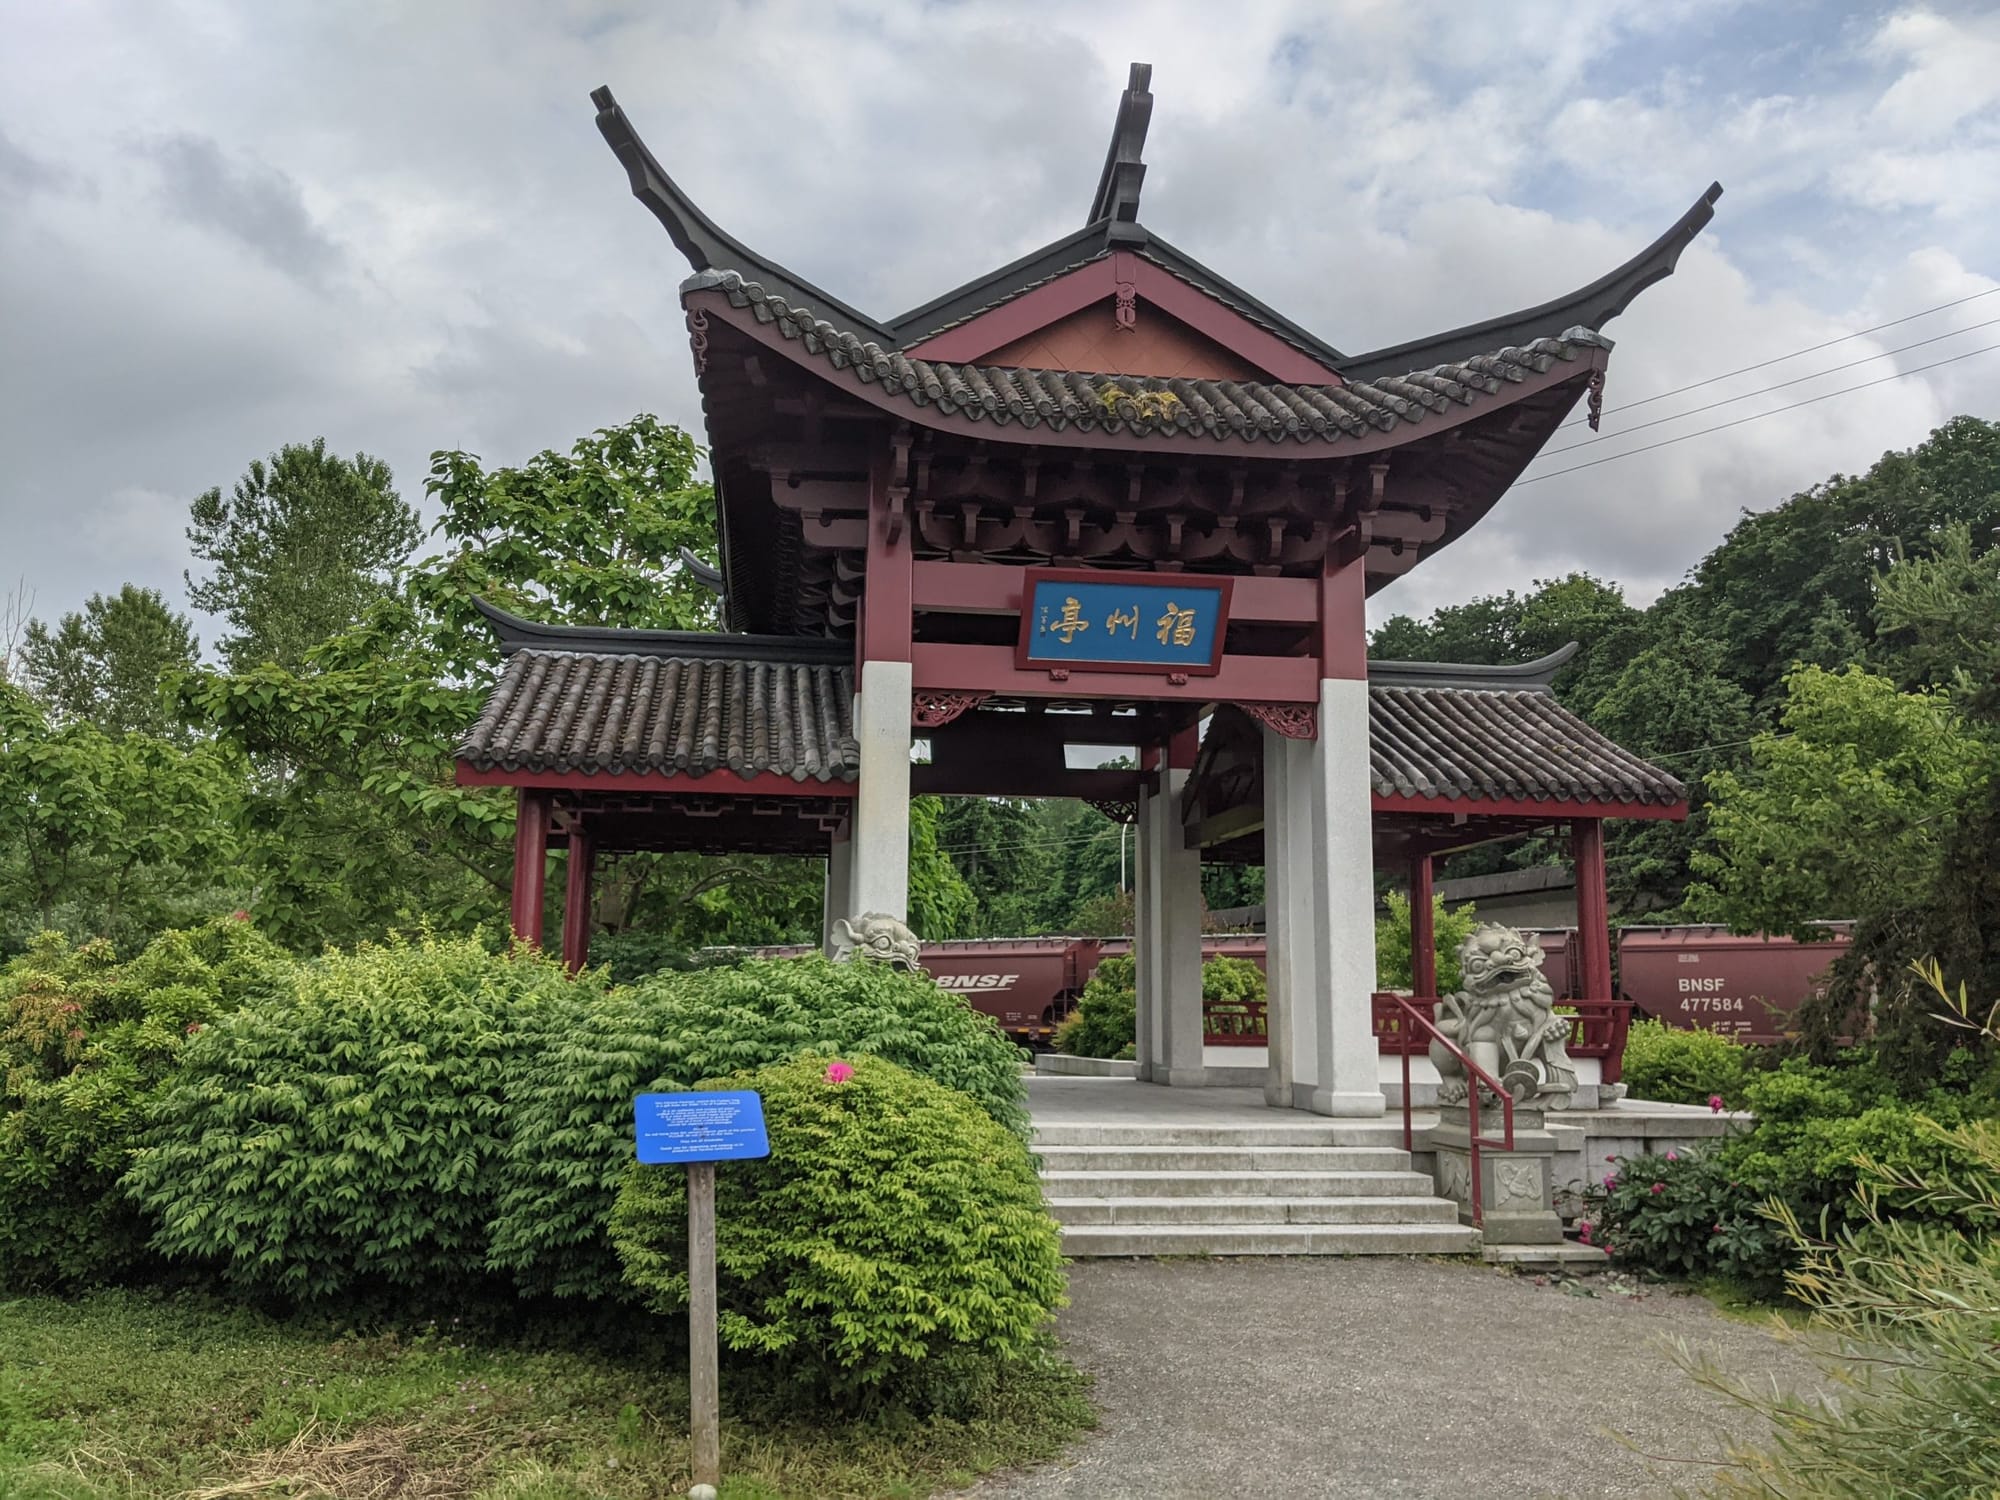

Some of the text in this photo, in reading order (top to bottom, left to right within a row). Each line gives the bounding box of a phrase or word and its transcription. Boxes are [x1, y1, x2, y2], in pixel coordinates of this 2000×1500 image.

[935, 974, 1020, 988] BNSF
[1678, 978, 1725, 993] BNSF
[1680, 997, 1744, 1012] 477584
